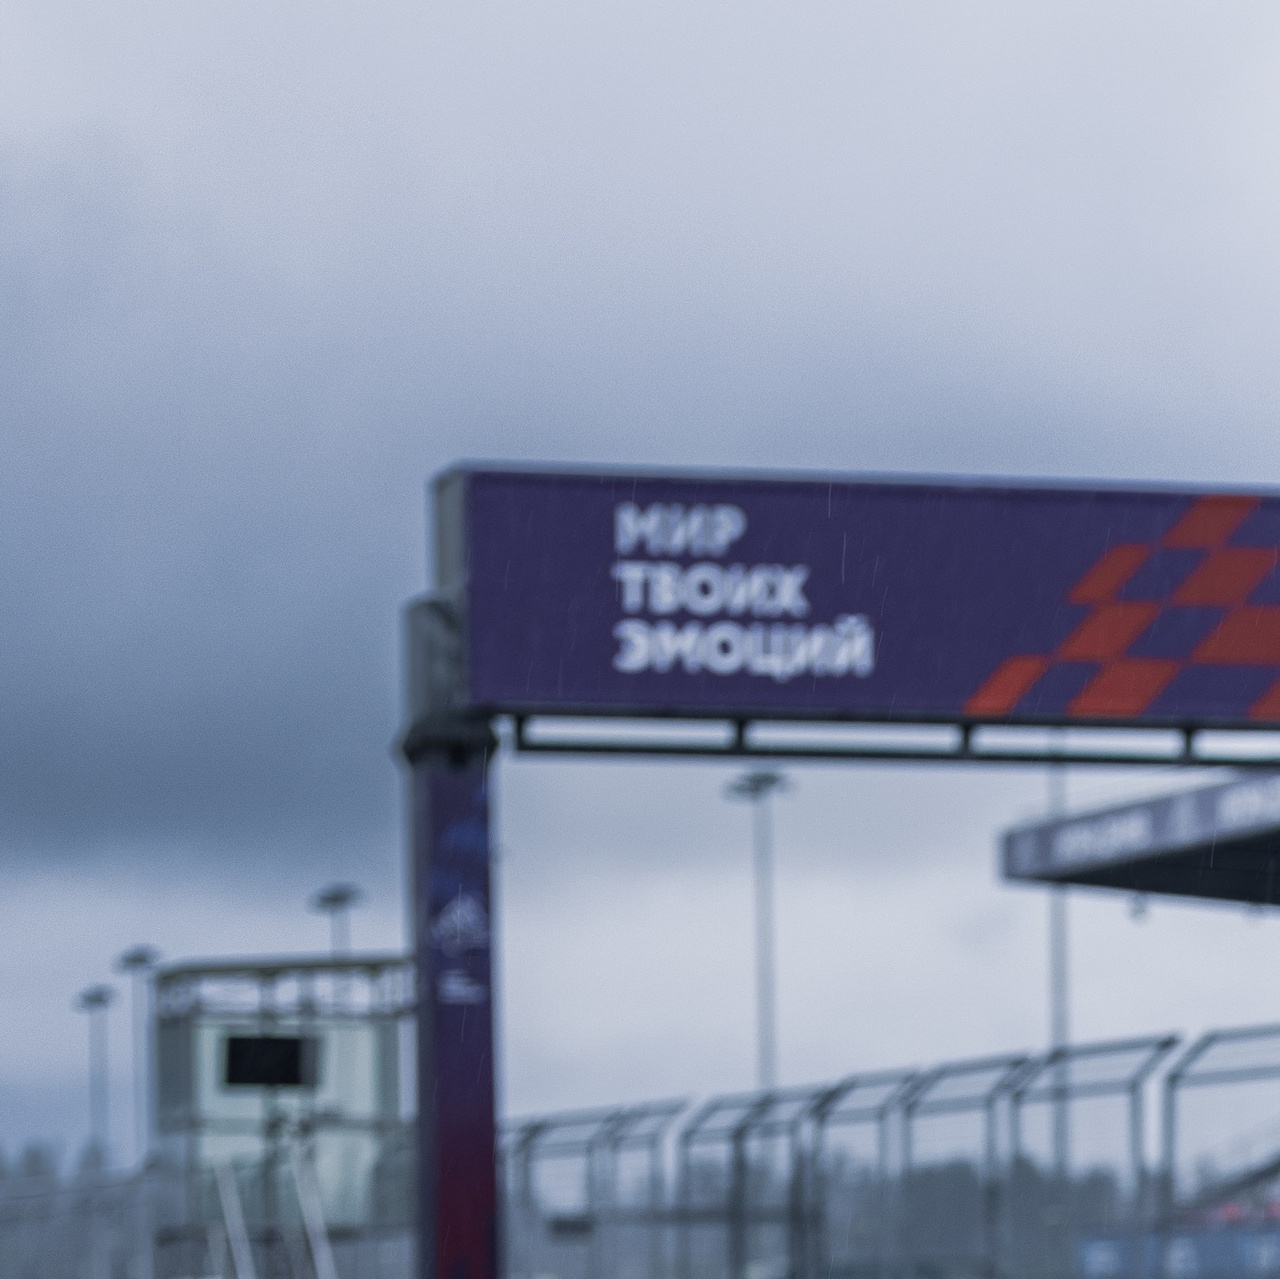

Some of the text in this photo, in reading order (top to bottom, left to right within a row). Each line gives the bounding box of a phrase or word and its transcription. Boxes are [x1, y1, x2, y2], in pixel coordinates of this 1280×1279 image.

[613, 502, 747, 556] МИР
[610, 560, 811, 617] ТВОИХ
[612, 613, 875, 683] ЭМОЦИЙ
